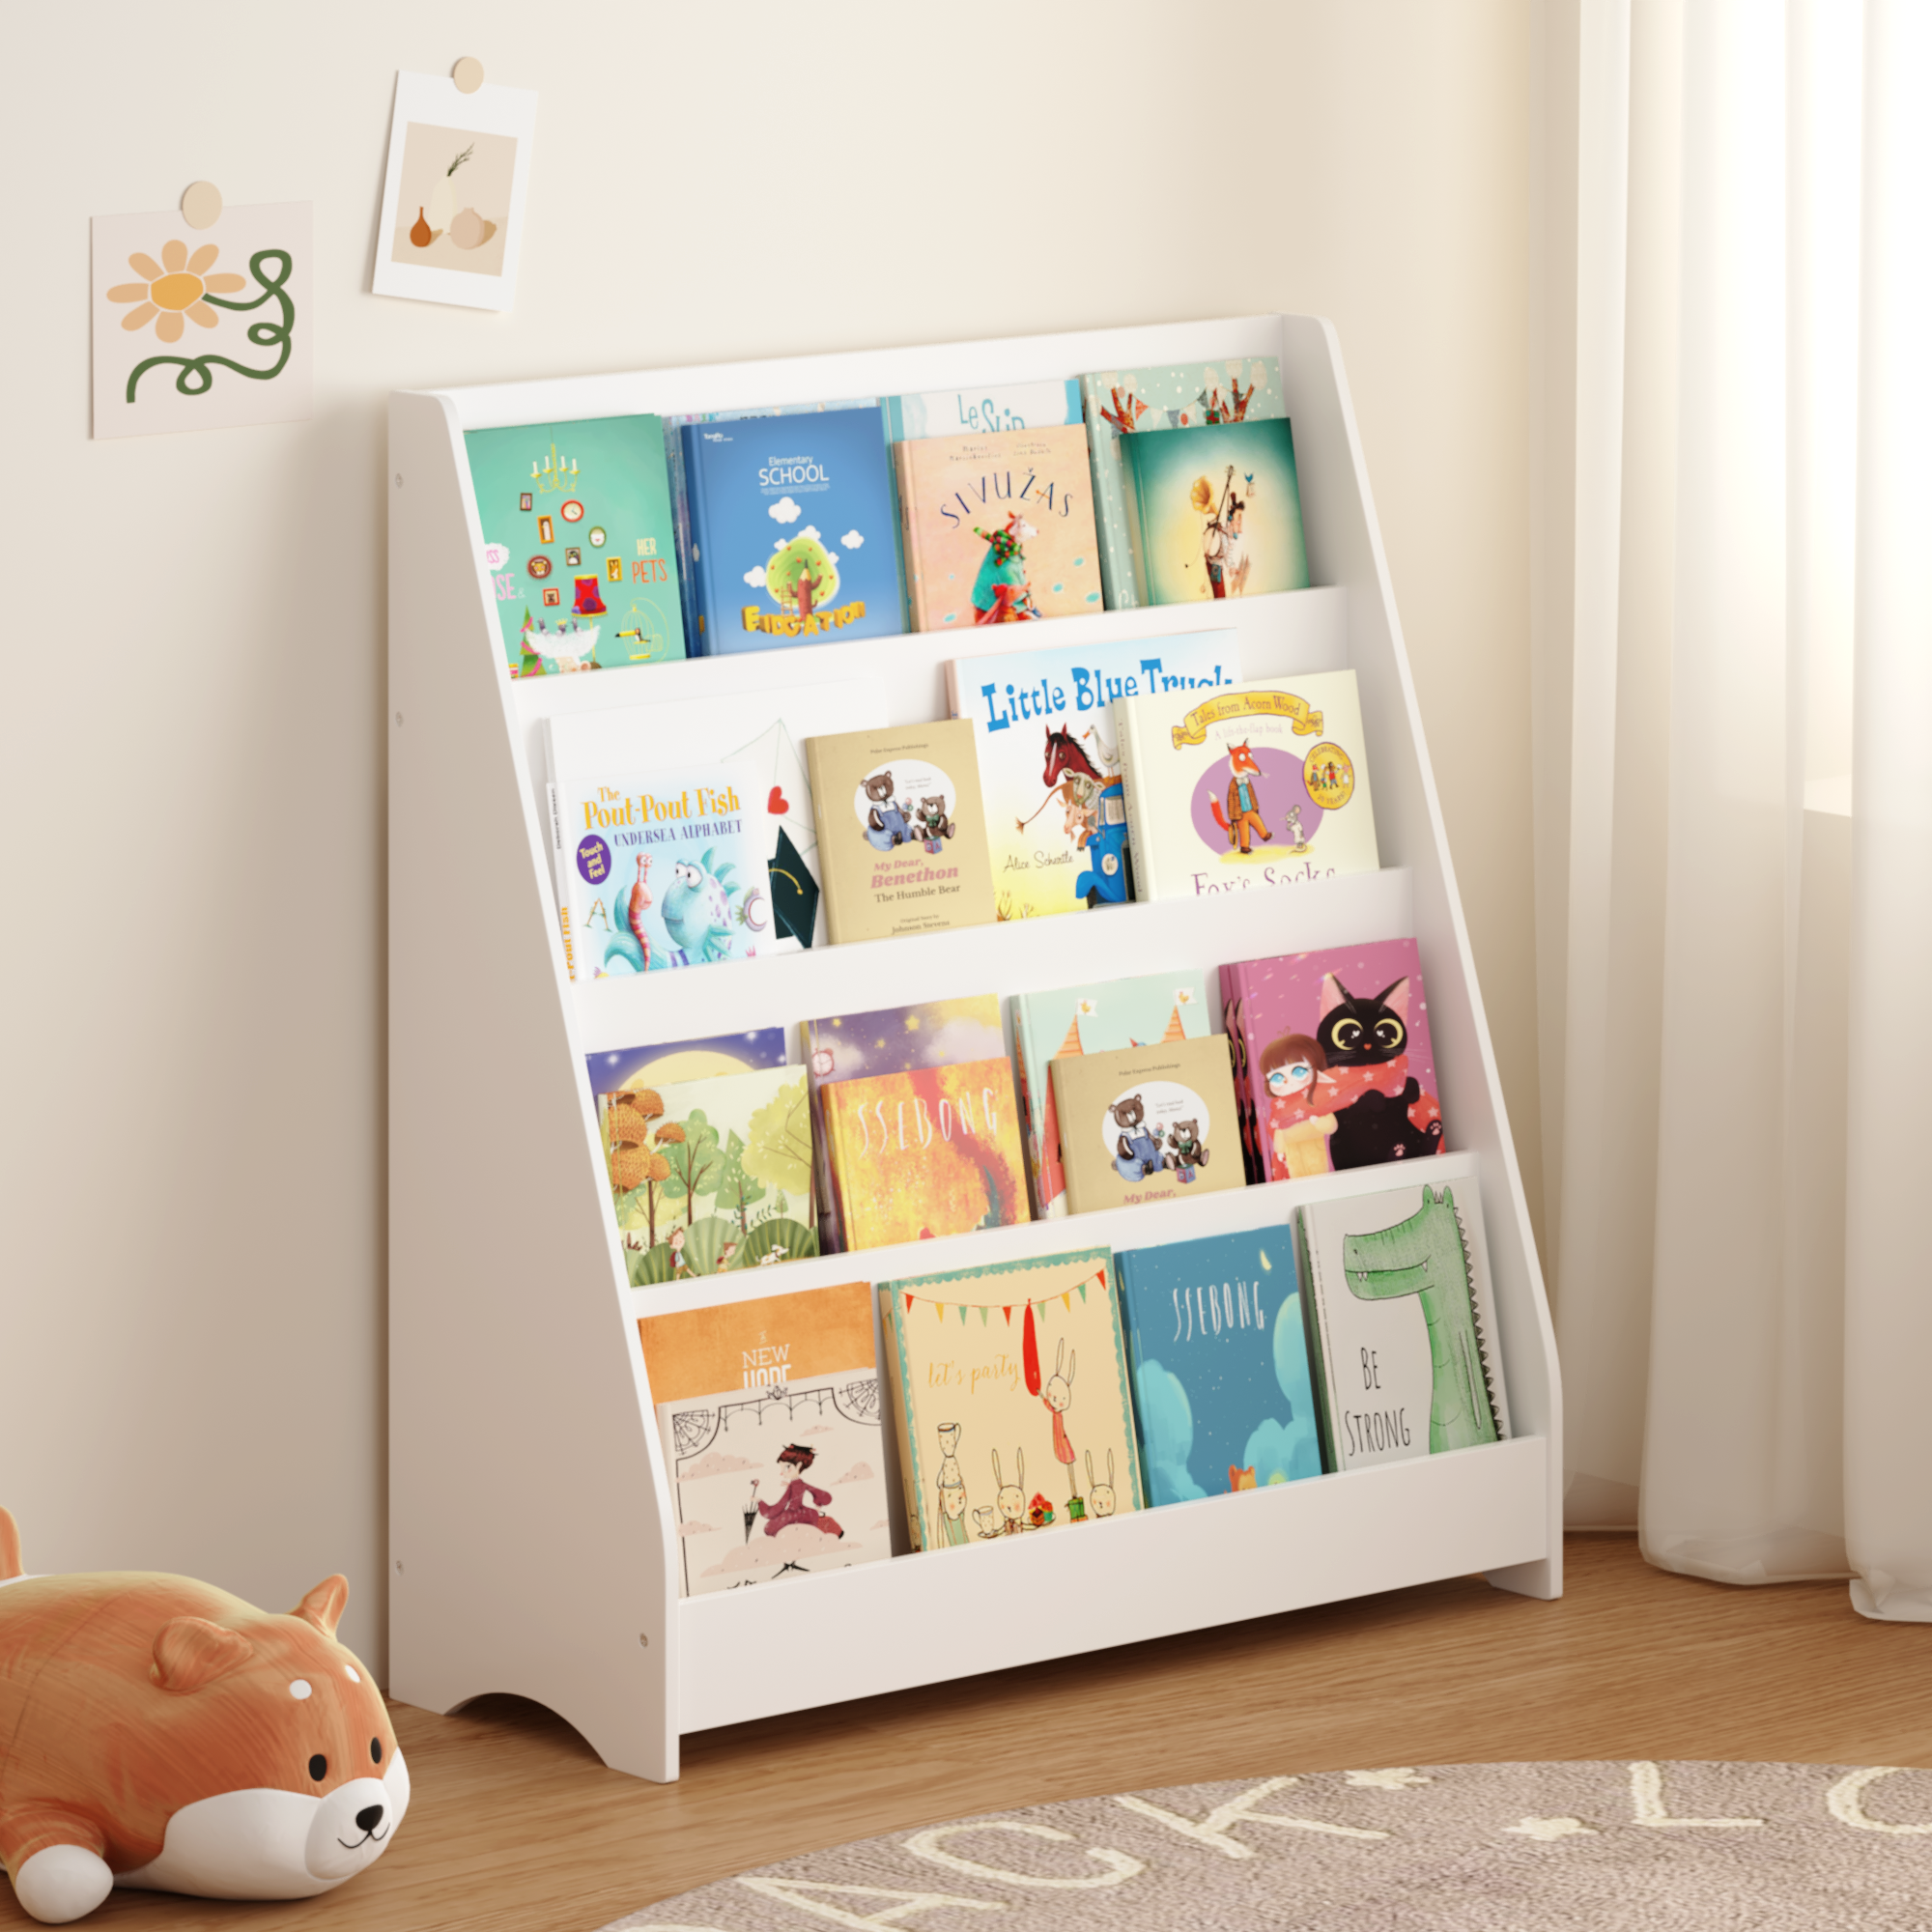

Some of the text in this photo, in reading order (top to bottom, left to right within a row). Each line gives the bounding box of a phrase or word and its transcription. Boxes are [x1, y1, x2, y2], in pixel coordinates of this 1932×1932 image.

[957, 394, 980, 430] Le
[768, 456, 813, 468] Elementary
[758, 465, 830, 486] SCHOOL
[940, 467, 1074, 529] SIVUŽAS
[637, 537, 657, 556] HER
[631, 558, 668, 584] PETS
[493, 573, 517, 601] SE
[980, 679, 1066, 733] Little
[1071, 668, 1139, 711] Blue
[1190, 696, 1301, 726] Tales from Acorn Wood
[597, 786, 620, 803] The
[581, 785, 741, 831] Pout-Pout Fish
[613, 818, 743, 847] UNDERSEA ALPHABET
[579, 841, 604, 860] Touch
[586, 853, 603, 868] and
[1003, 854, 1030, 873] Alice
[588, 867, 606, 880] Feel
[870, 867, 959, 889] Benethon
[873, 858, 924, 872] My Dear,
[874, 885, 960, 903] The Humble Bear
[858, 1087, 999, 1158] SSEBONG
[1123, 1188, 1177, 1205] My Dear,
[1173, 1281, 1264, 1342] SSEBONG
[742, 1343, 790, 1369] NEW
[1360, 1347, 1381, 1390] BE
[928, 1353, 1021, 1395] let's party
[1345, 1407, 1411, 1457] STRONG
